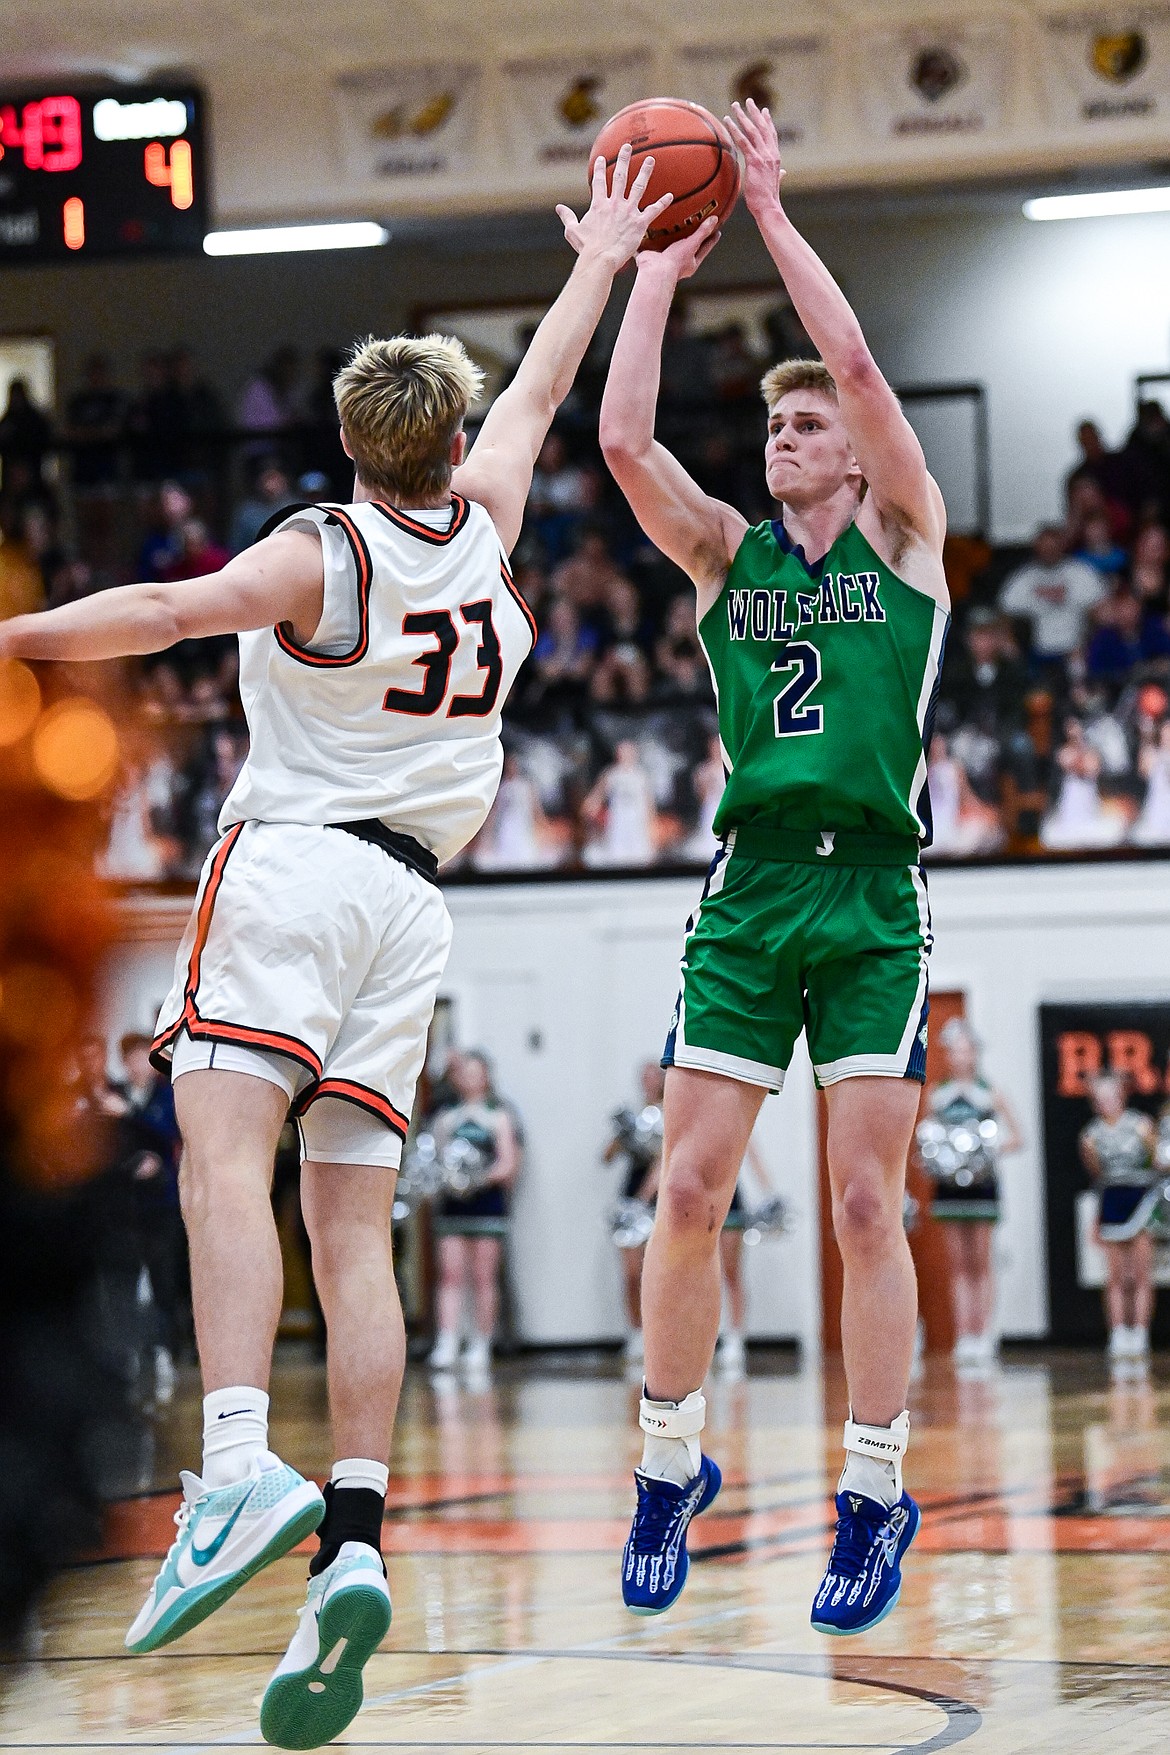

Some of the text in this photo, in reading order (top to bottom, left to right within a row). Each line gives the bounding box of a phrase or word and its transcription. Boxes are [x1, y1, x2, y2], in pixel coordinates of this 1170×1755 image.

[144, 140, 193, 210] 4
[63, 197, 85, 250] 1
[382, 598, 503, 718] 33
[771, 641, 823, 737] 2
[1057, 1030, 1170, 1097] BR
